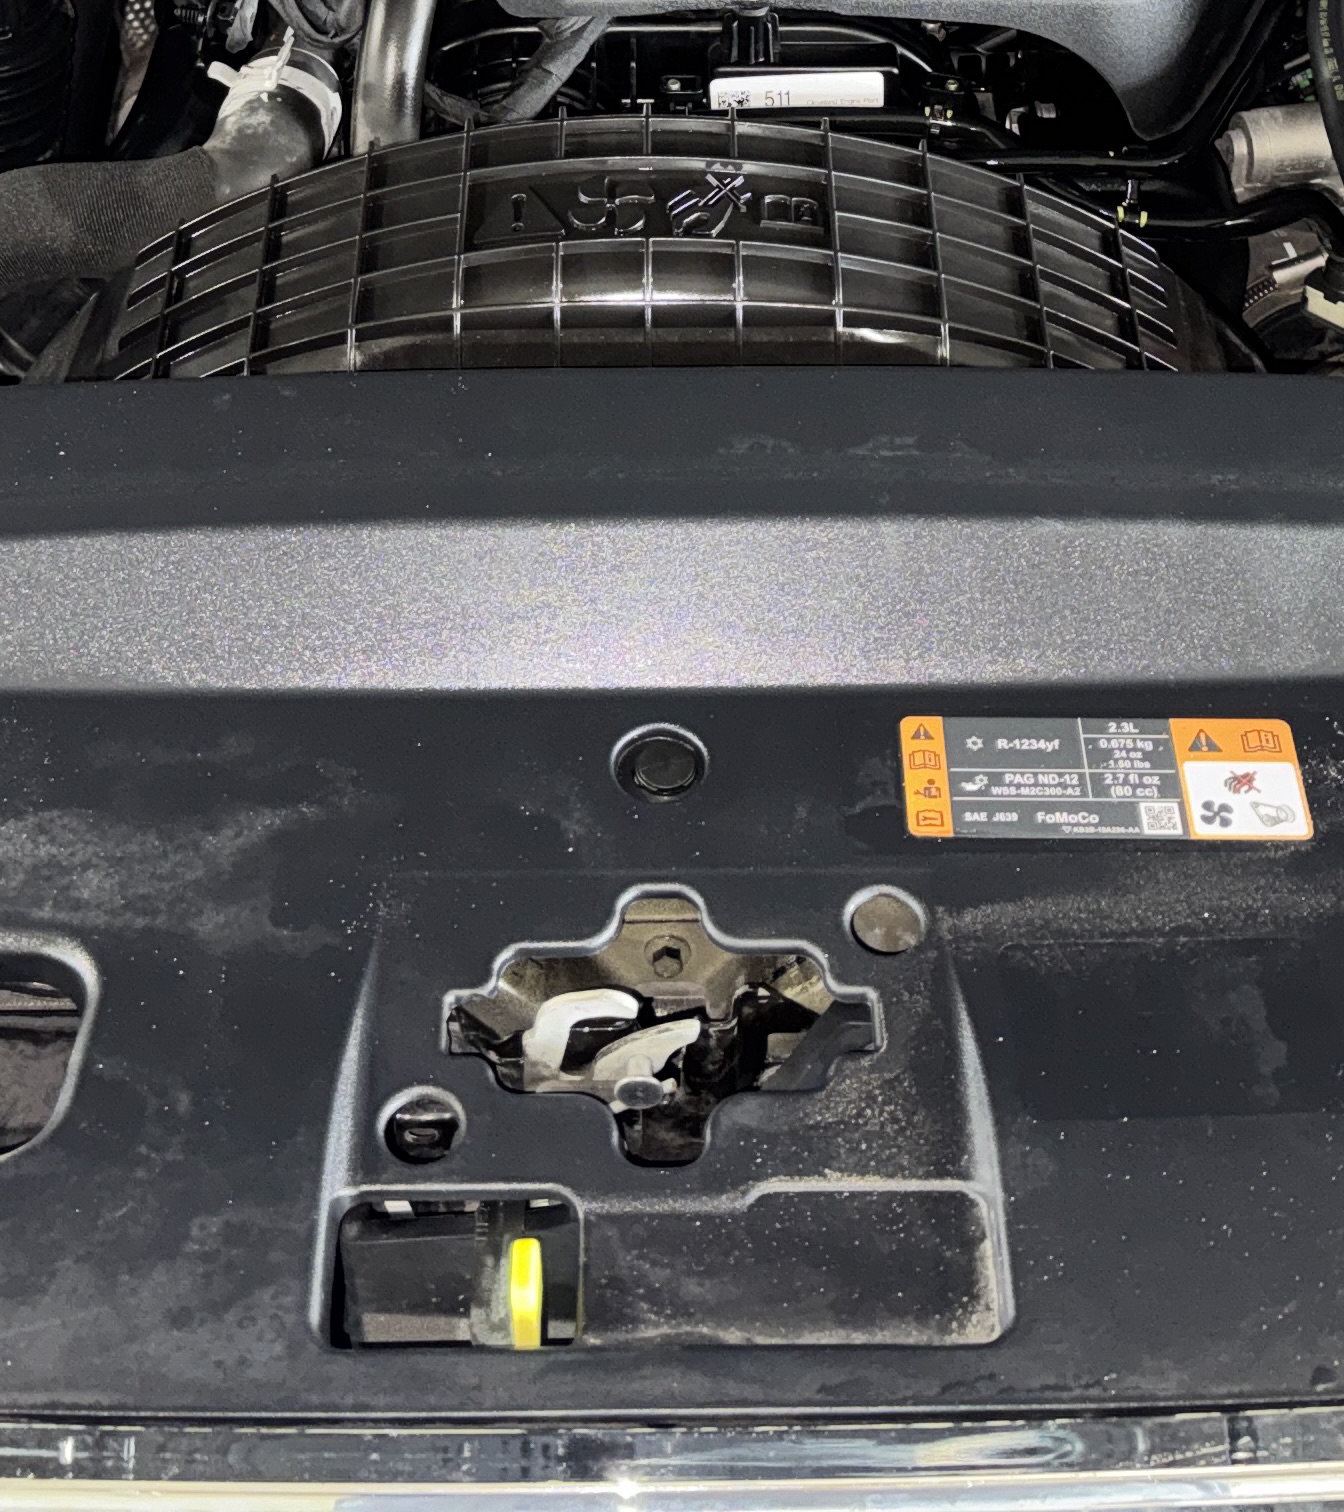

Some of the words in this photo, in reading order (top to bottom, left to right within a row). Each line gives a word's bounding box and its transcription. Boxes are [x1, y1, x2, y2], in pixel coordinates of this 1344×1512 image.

[764, 90, 791, 106] 511
[1107, 721, 1139, 733] 2.3L
[996, 738, 1060, 752] R-1234yf
[1099, 738, 1134, 748] 0.675
[1136, 738, 1154, 751] kg
[1113, 749, 1127, 758] 24
[1133, 759, 1151, 768] lbs
[1004, 773, 1034, 784] PAG
[1037, 773, 1080, 785] ND-12
[1103, 773, 1125, 784] 2.7
[1128, 773, 1140, 784] fl
[1142, 775, 1160, 785] oz
[963, 811, 987, 821] SAE
[992, 812, 1019, 821] J639
[1035, 811, 1100, 823] FoMoCo
